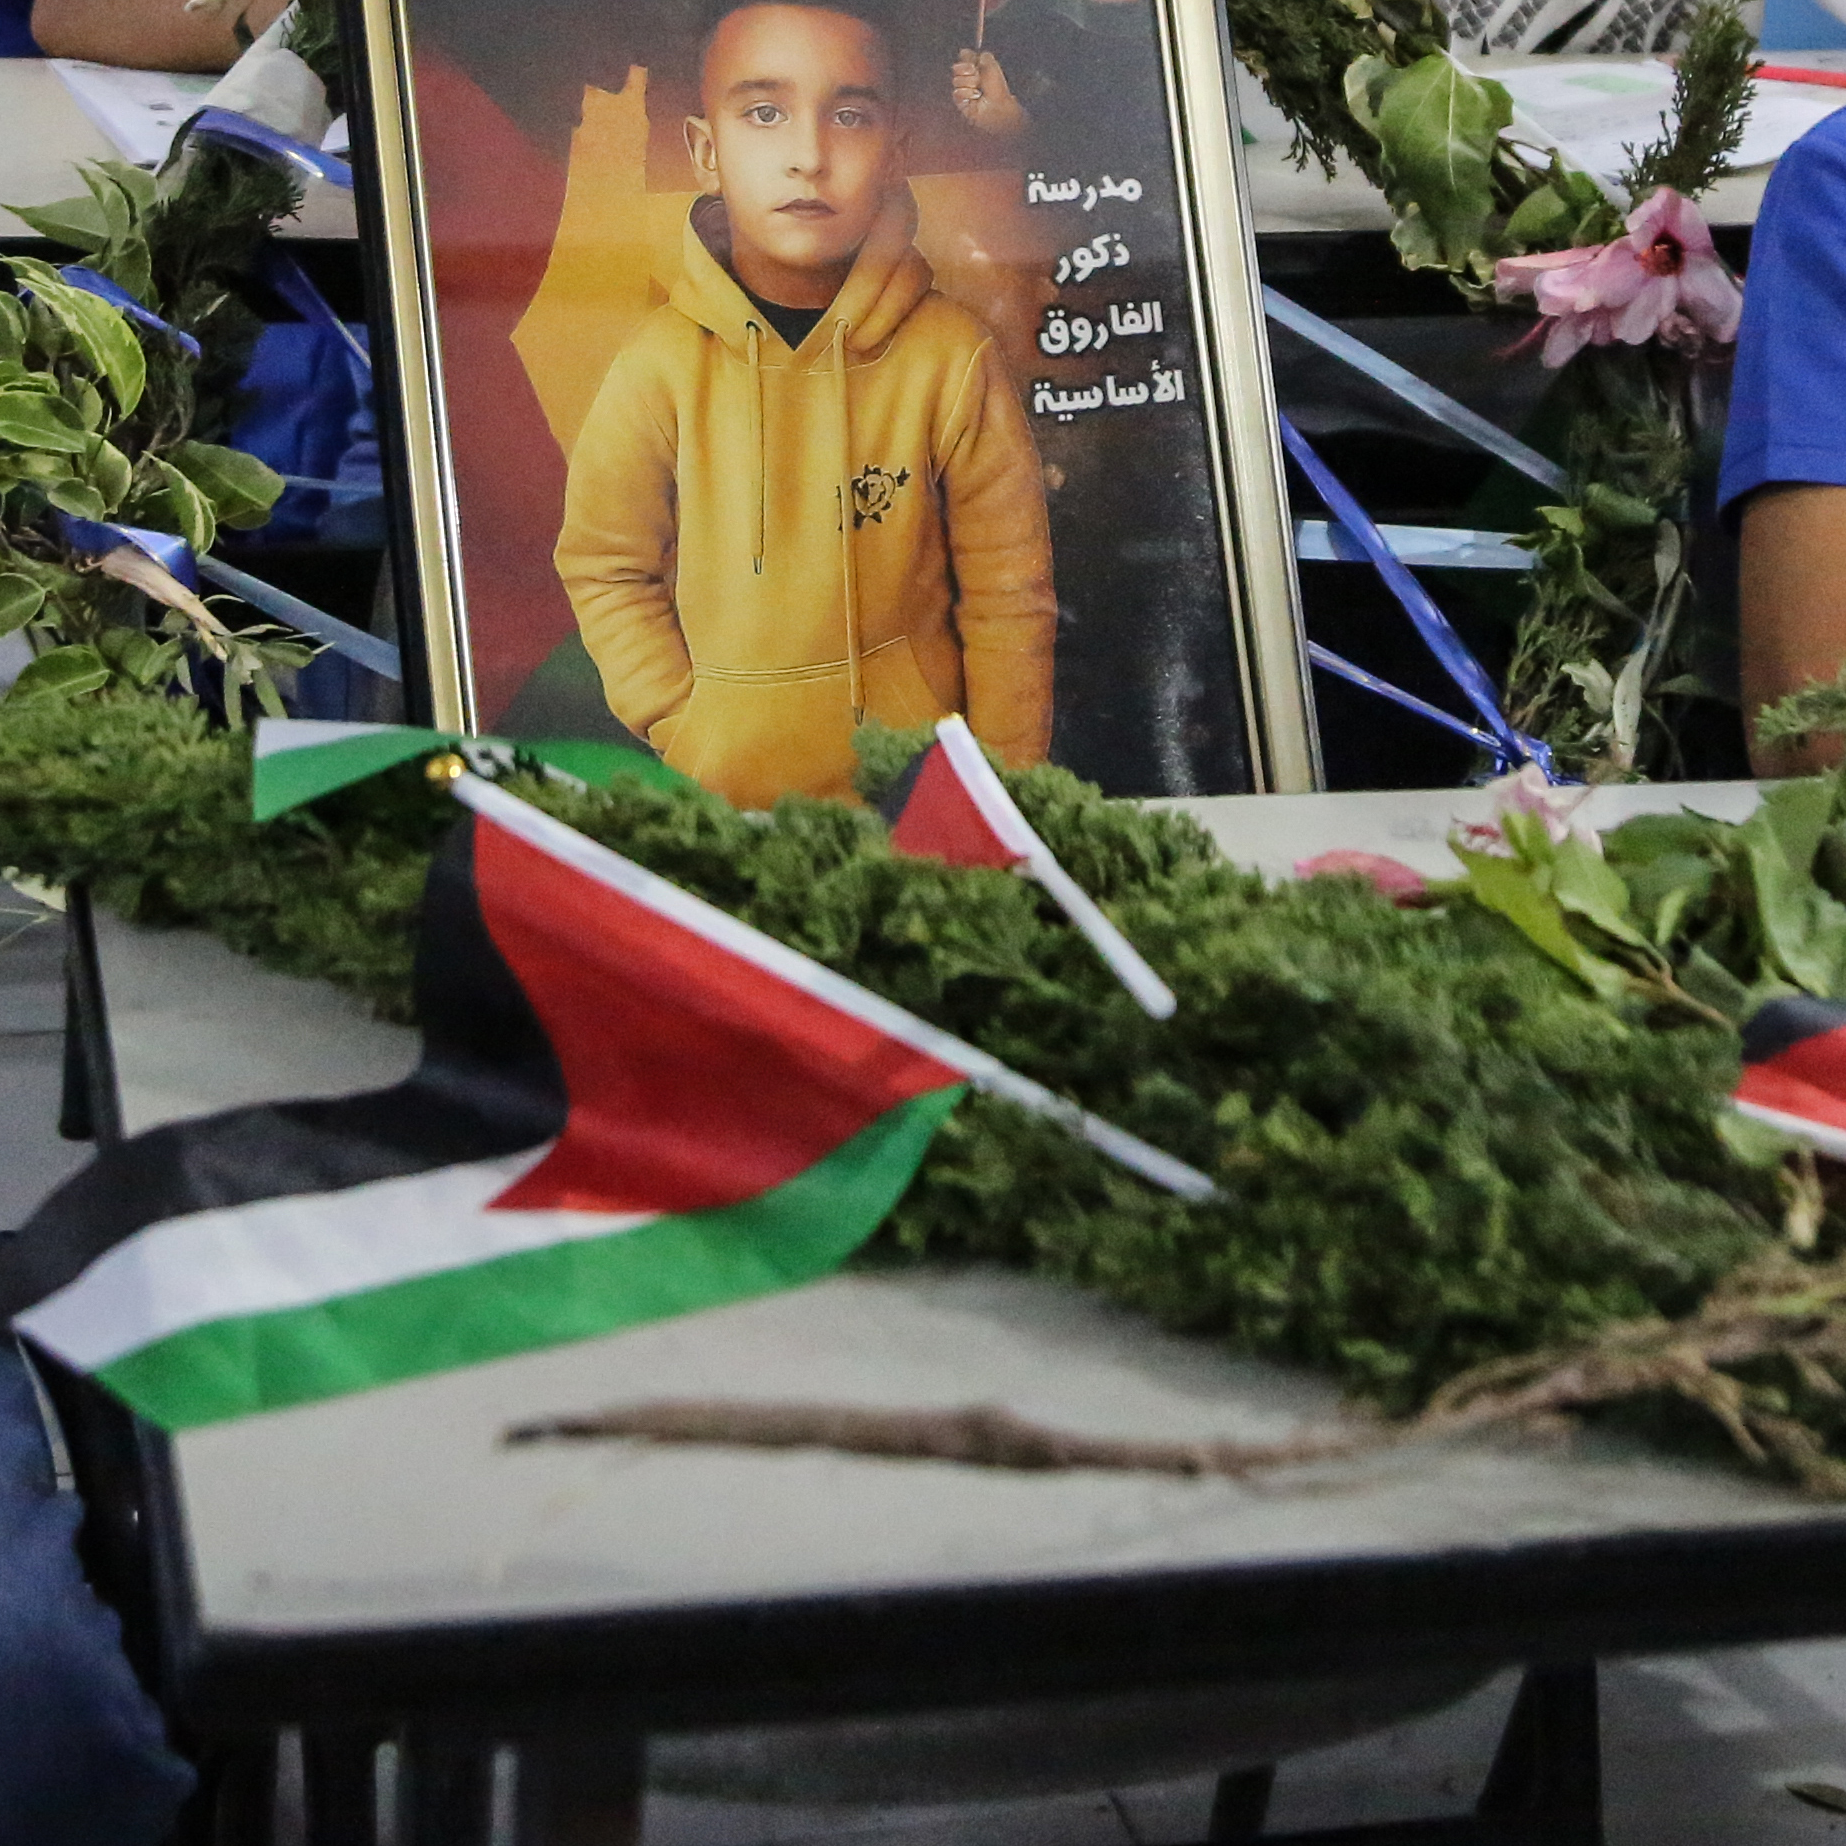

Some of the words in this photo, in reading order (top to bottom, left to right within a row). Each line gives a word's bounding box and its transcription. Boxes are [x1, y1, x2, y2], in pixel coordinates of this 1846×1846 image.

[1027, 172, 1143, 211] مدرسة
[1055, 233, 1131, 283] ذكور
[1040, 301, 1165, 354] الفاروق
[1033, 359, 1186, 422] الأساسية
